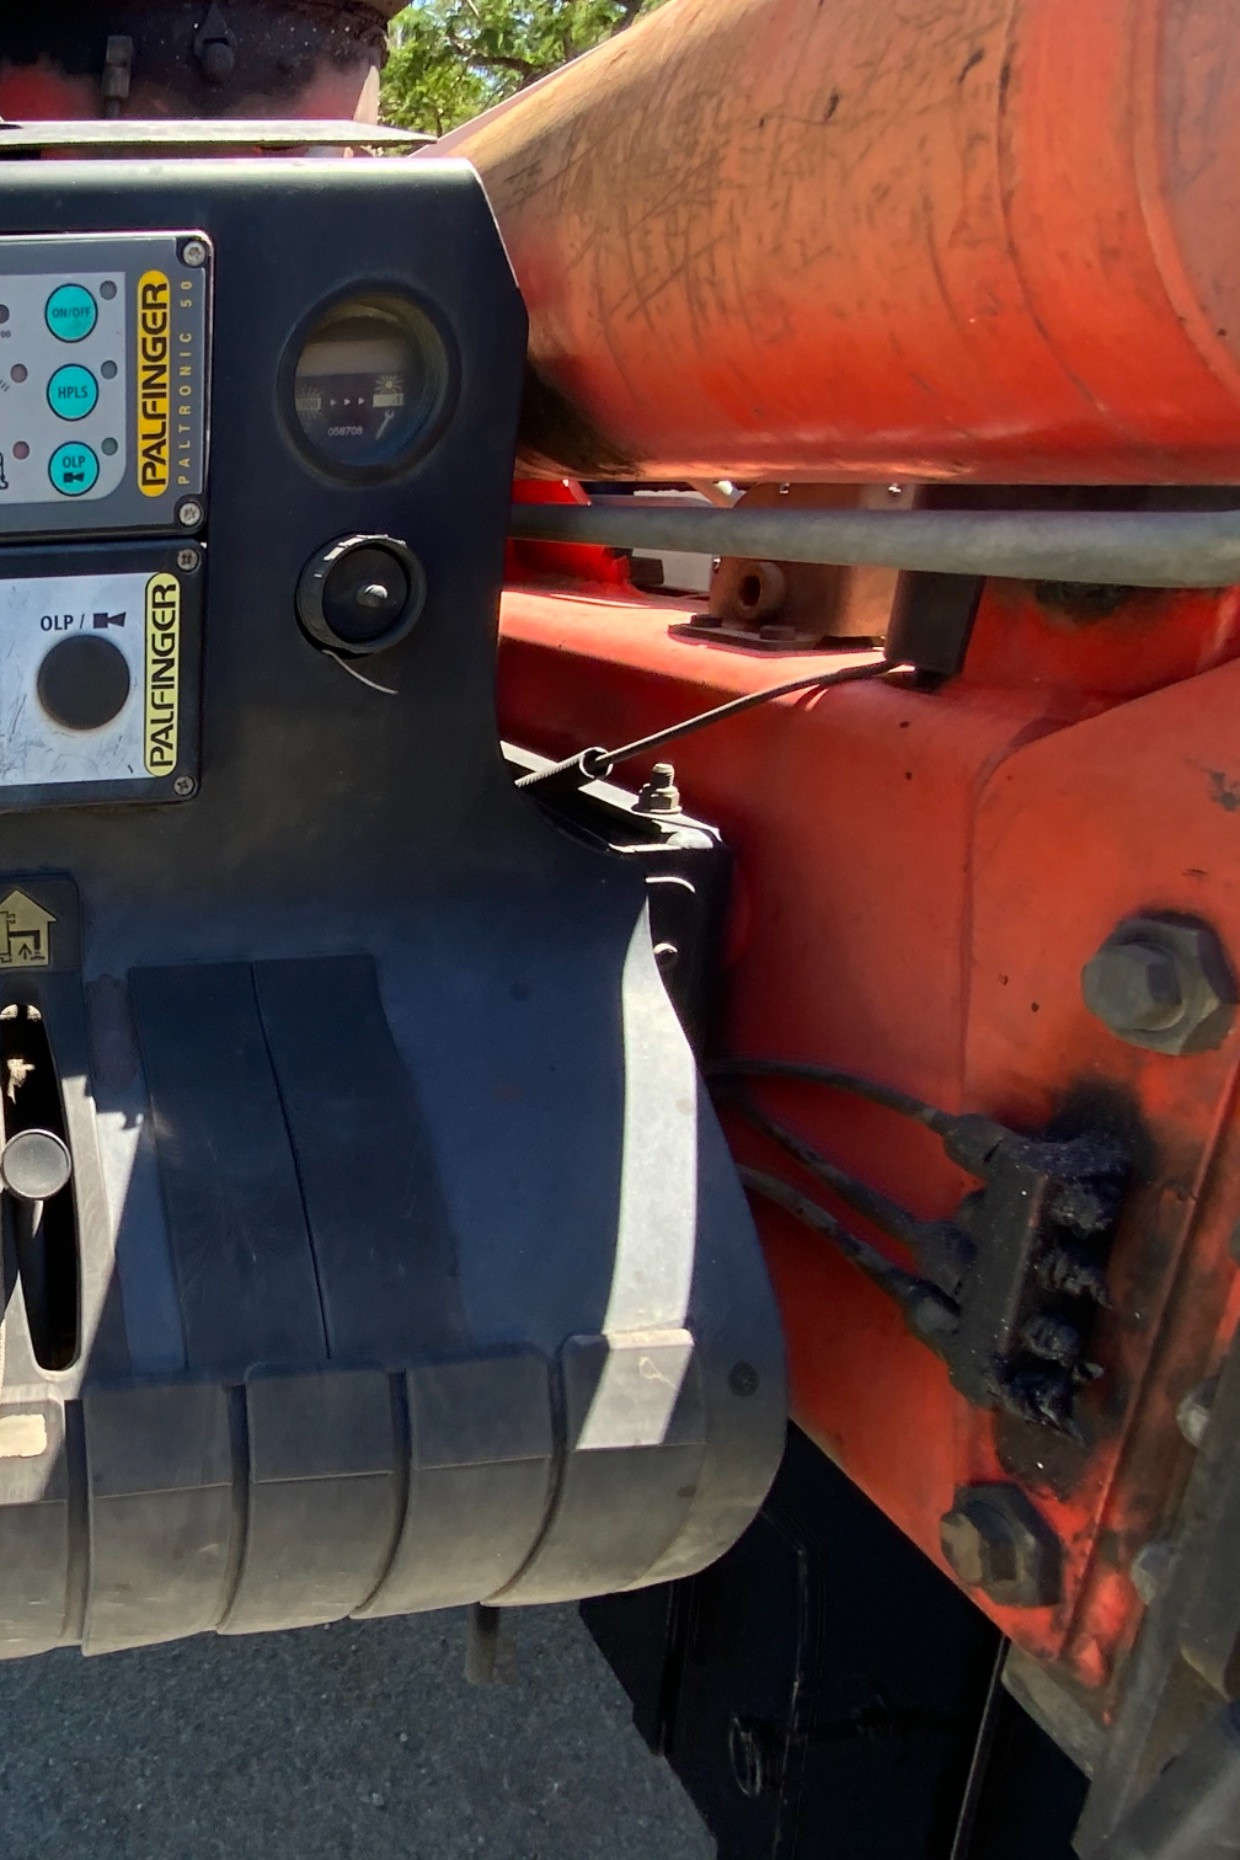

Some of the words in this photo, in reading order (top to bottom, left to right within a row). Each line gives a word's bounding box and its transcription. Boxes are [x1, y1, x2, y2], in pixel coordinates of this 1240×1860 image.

[179, 280, 193, 308] 50
[52, 306, 91, 319] ON/OFF
[57, 385, 89, 399] HPLS
[141, 282, 168, 486] PALFINGER
[177, 331, 193, 485] PALTRONIC
[62, 455, 86, 468] OLP
[40, 614, 75, 632] OLP
[149, 583, 177, 767] PALFINGER
